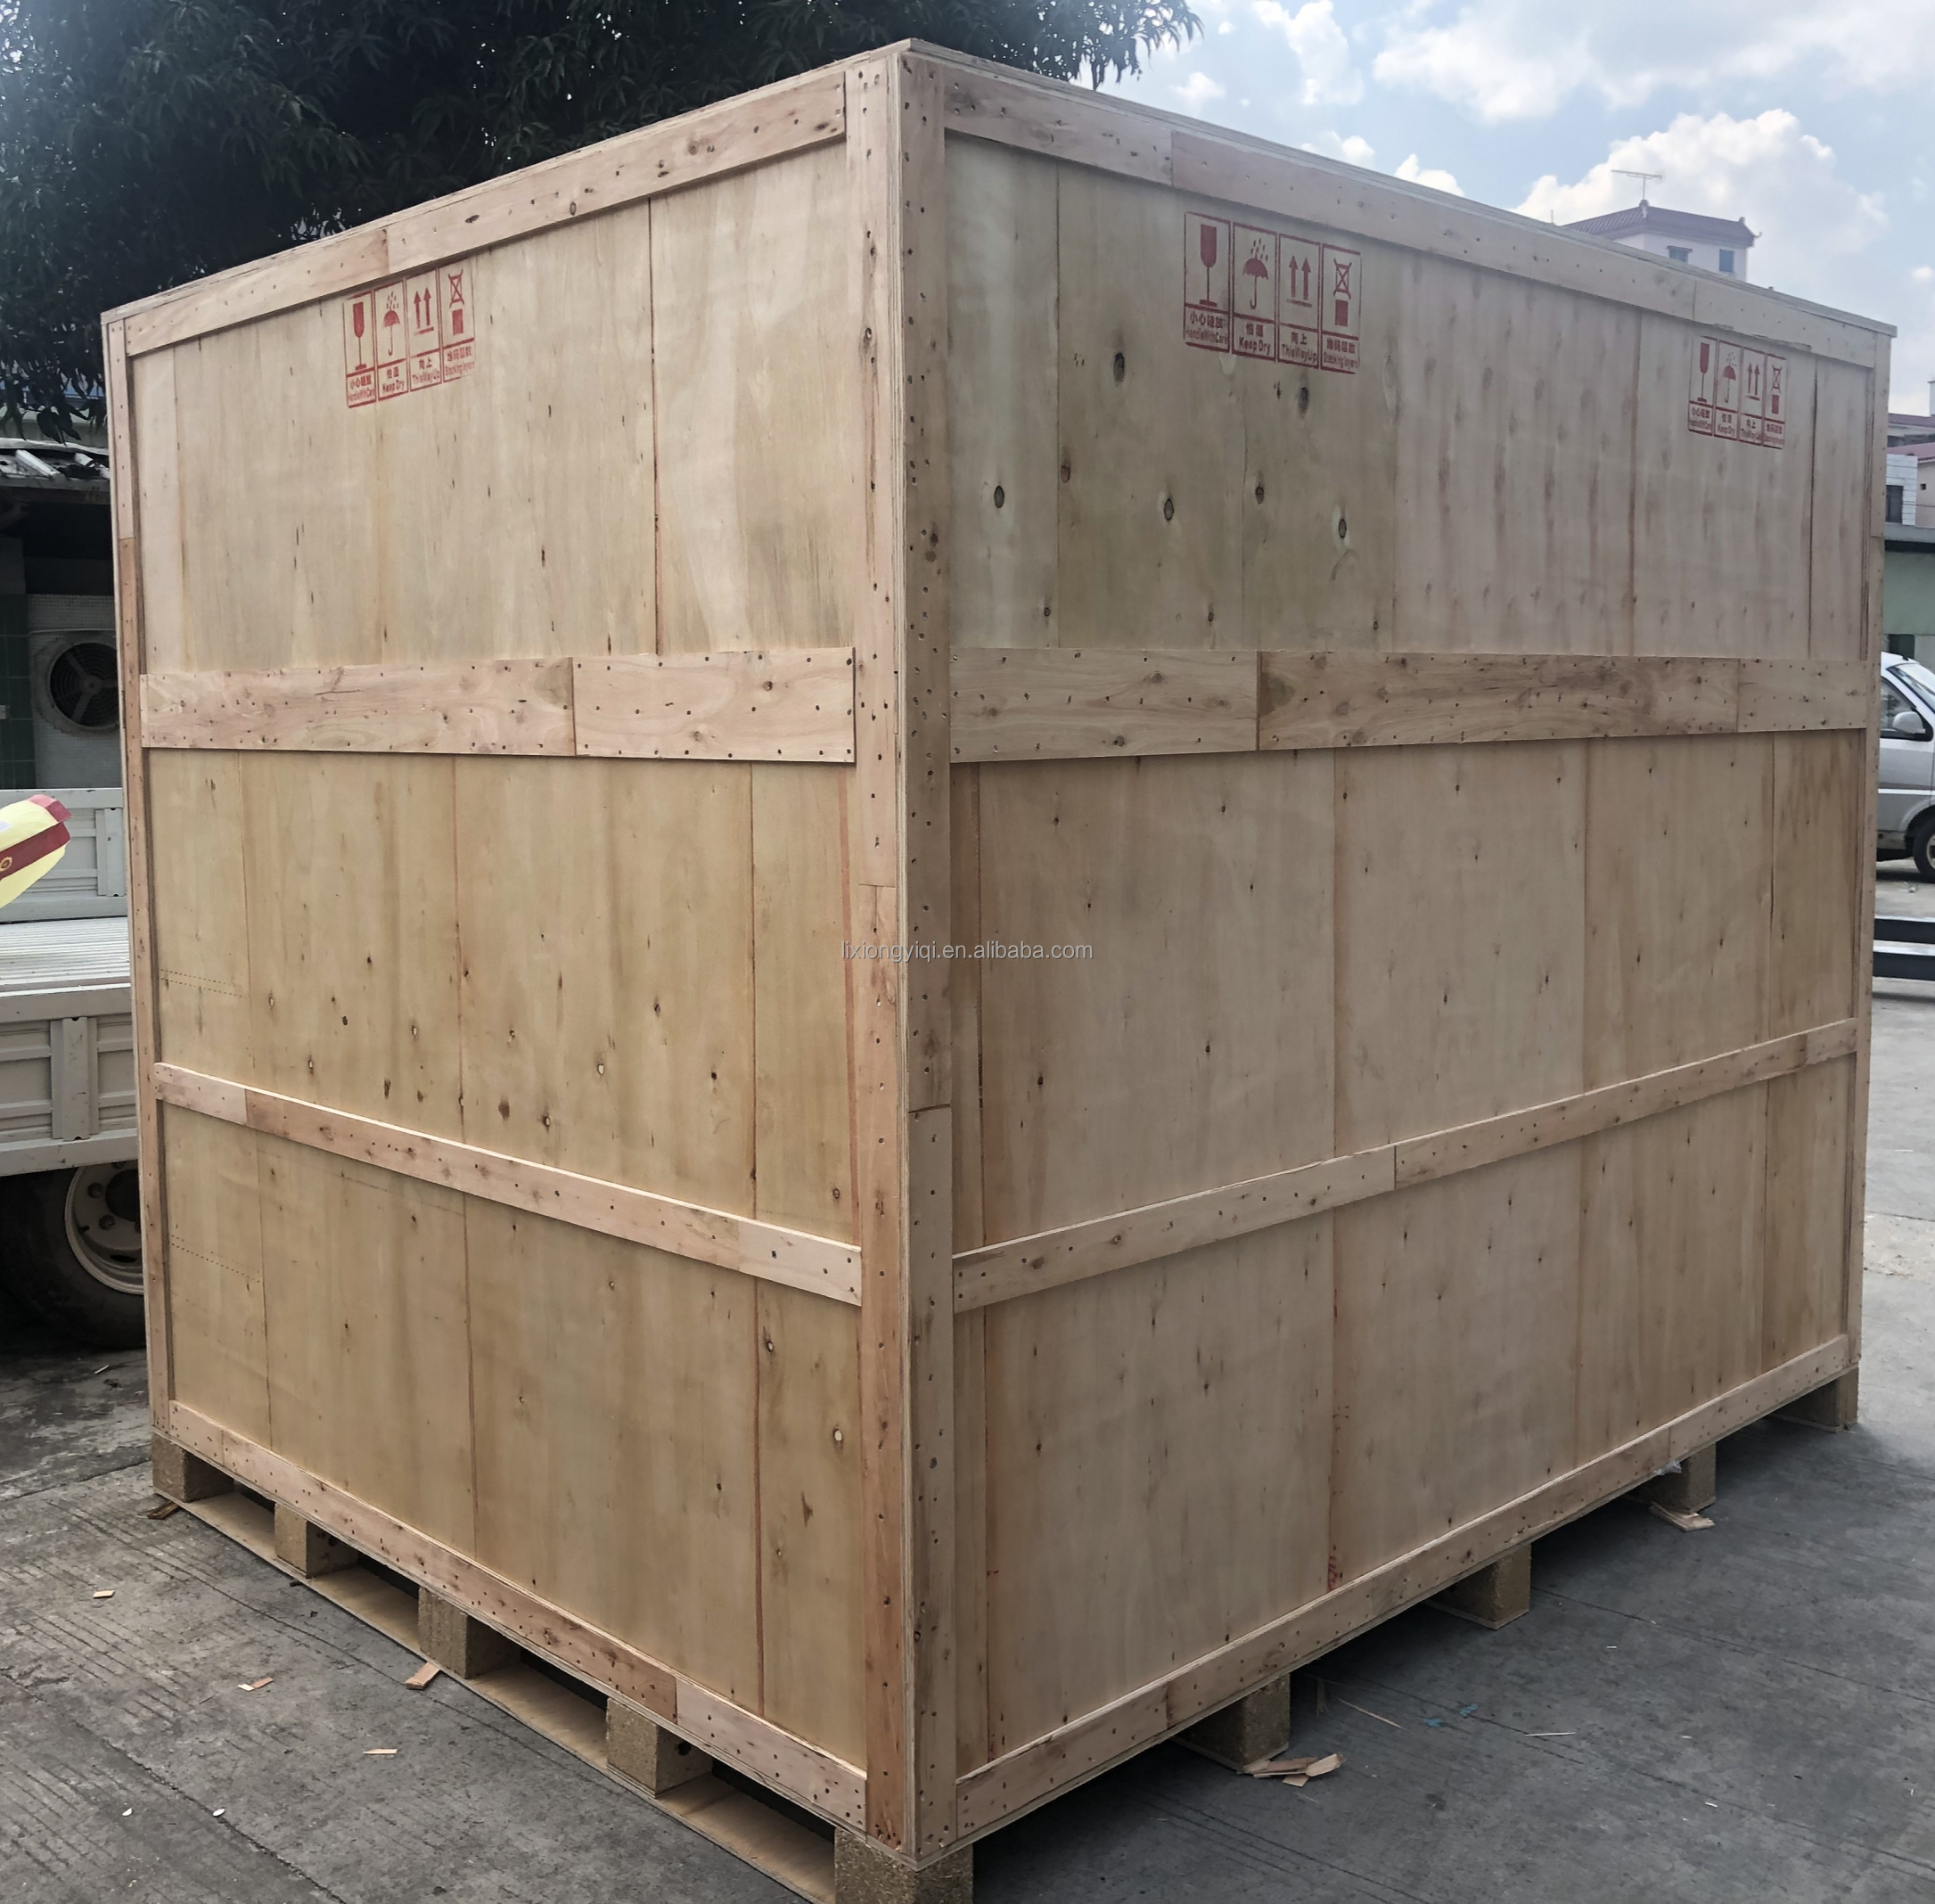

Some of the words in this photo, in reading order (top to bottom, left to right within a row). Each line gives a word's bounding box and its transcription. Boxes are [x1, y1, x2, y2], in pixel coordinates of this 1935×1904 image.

[1291, 332, 1308, 345] 向上
[1239, 336, 1257, 352] Keep
[1258, 340, 1271, 356] Dry
[419, 357, 432, 370] 向上
[382, 382, 395, 393] Keep
[396, 379, 405, 390] Dry
